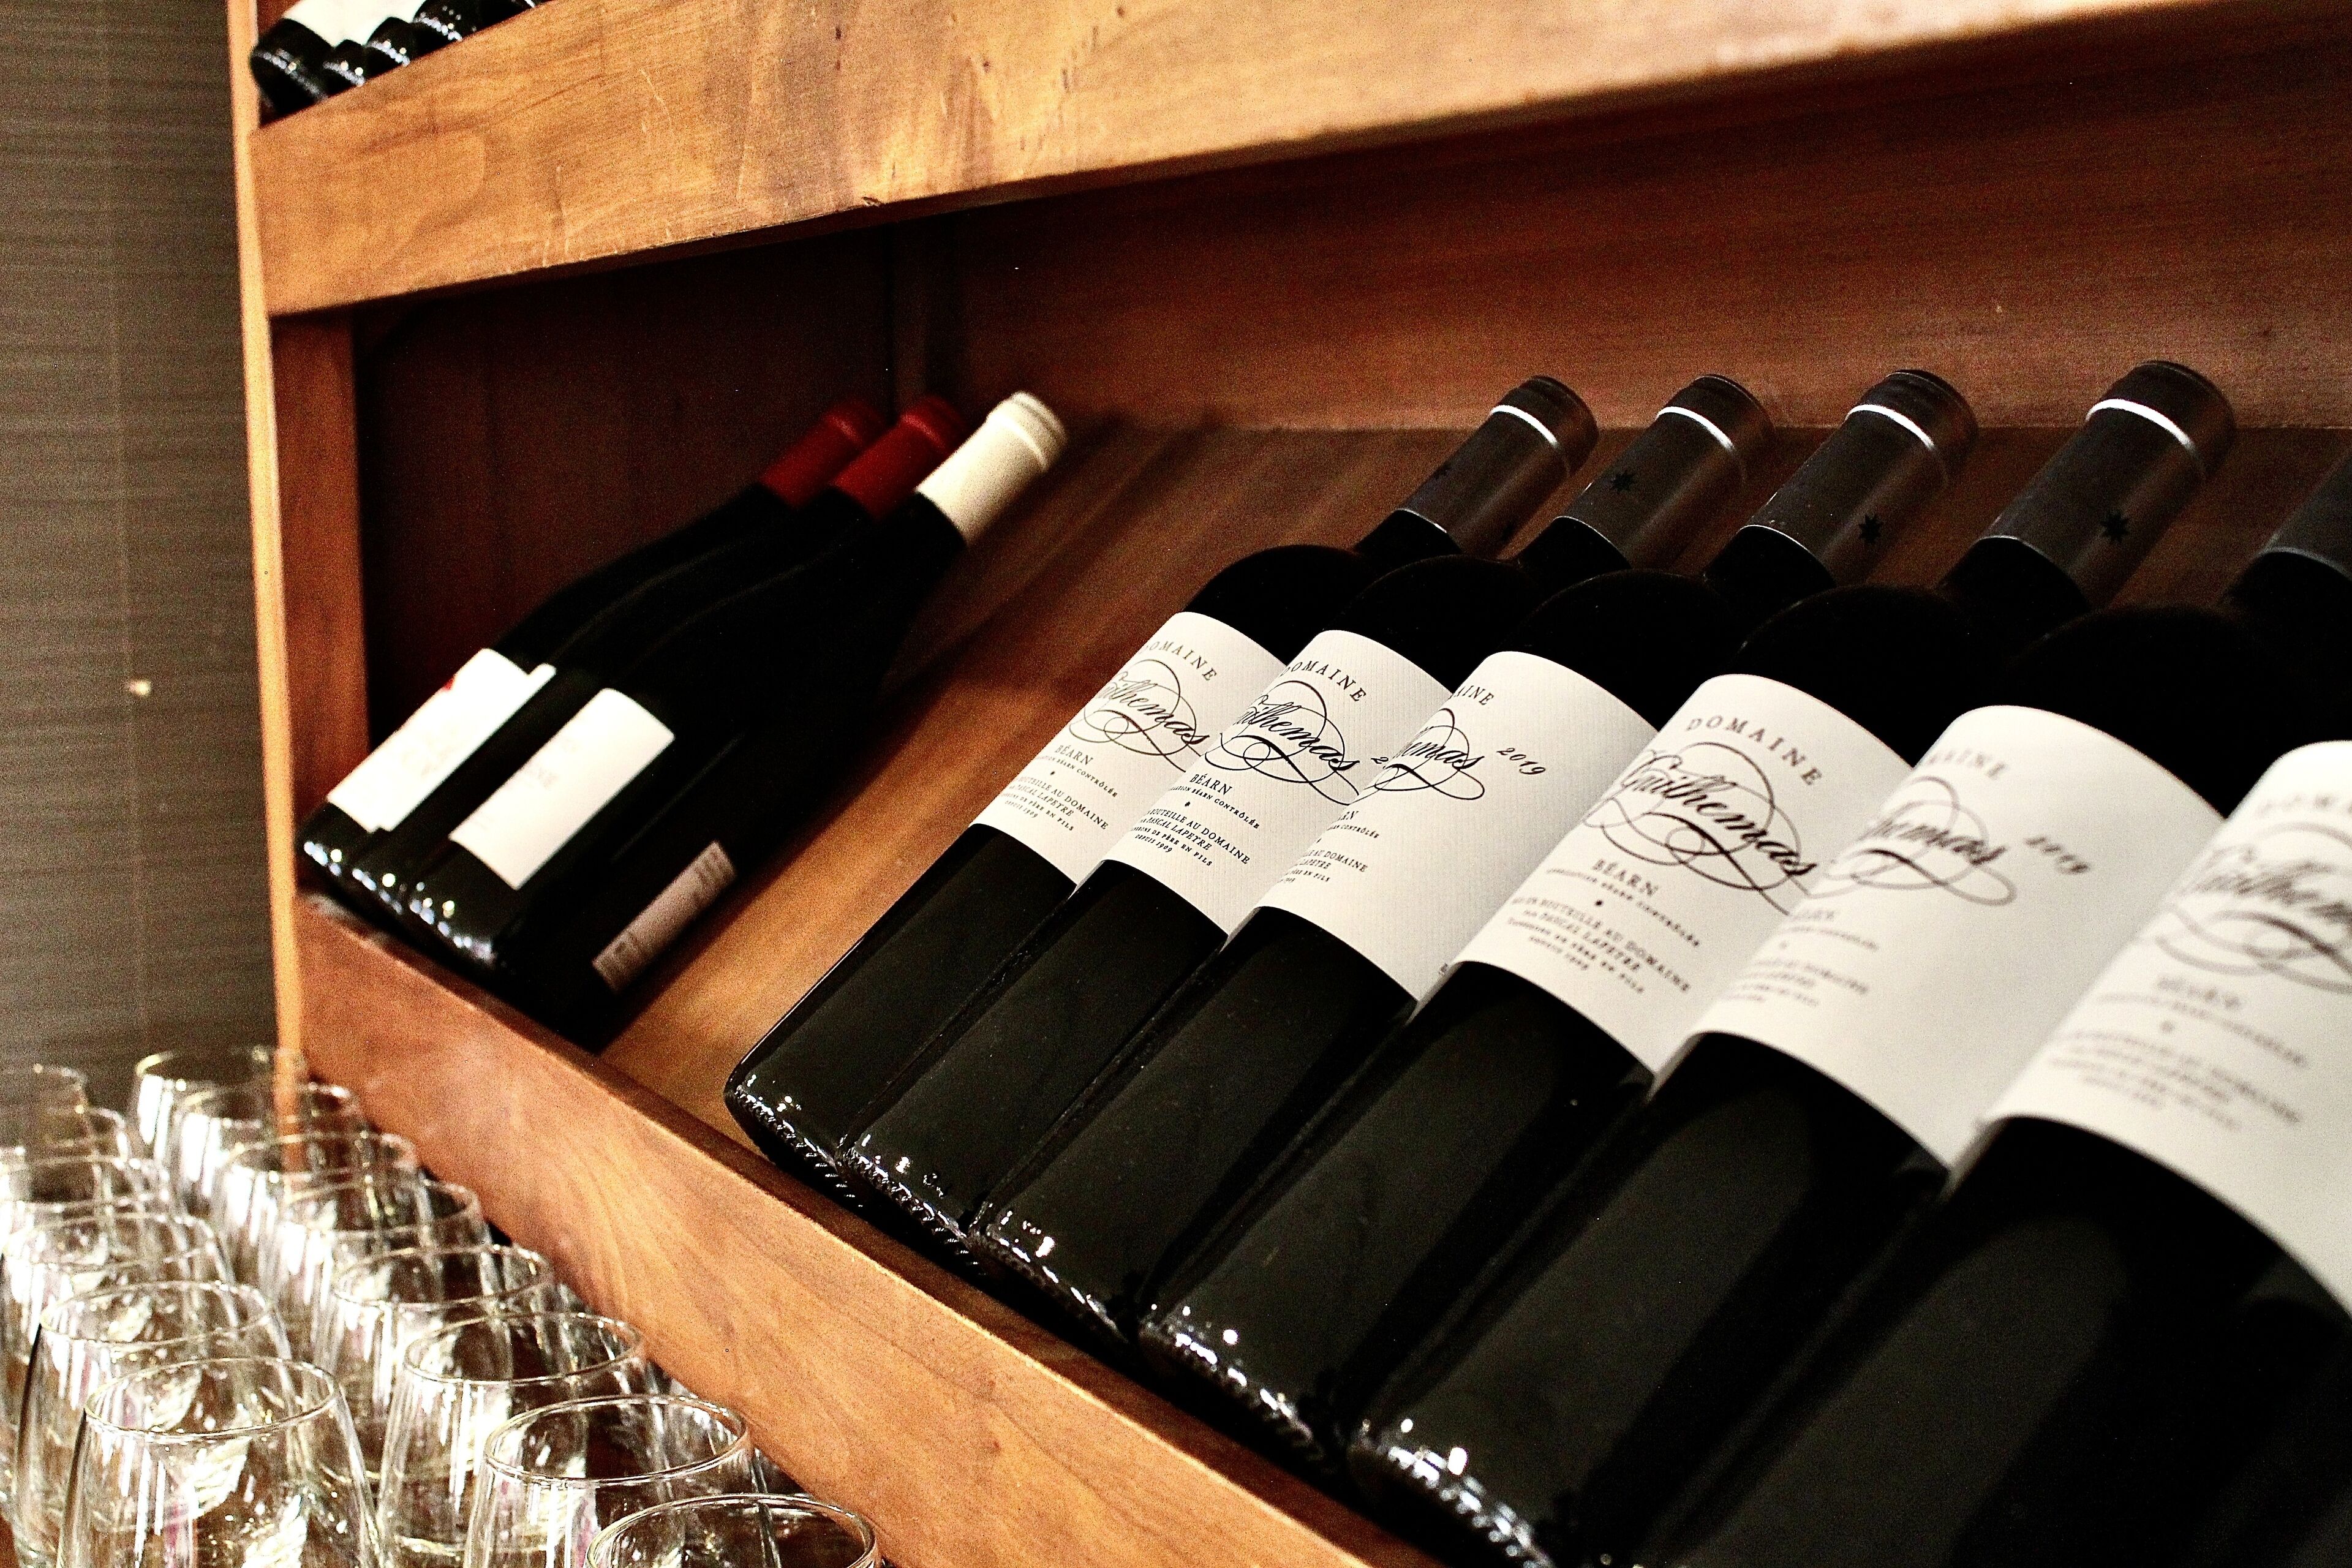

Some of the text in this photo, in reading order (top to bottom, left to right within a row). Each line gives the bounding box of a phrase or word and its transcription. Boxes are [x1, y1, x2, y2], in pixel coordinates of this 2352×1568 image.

[1146, 641, 1218, 681] OMAINE
[1055, 745, 1093, 765] BÉARN
[1496, 747, 1546, 775] 2019
[1686, 715, 1822, 785] DOMAINE
[1189, 774, 1232, 795] BÉARN
[1051, 789, 1065, 797] AU
[1064, 796, 1109, 830] DOMAINE
[1191, 788, 1213, 800] BÉARN
[1214, 798, 1260, 829] CONTRÔLÉE
[1057, 818, 1074, 831] FILS
[1170, 824, 1212, 850] LAPEYRE
[1155, 840, 1173, 853] 1909
[1161, 832, 1179, 845] PÈRE
[1181, 843, 1193, 853] EN
[1193, 851, 1213, 866] FILS
[1186, 820, 1201, 830] AU
[1200, 827, 1251, 864] DOMAINE
[1324, 851, 1368, 872] DOMAINE
